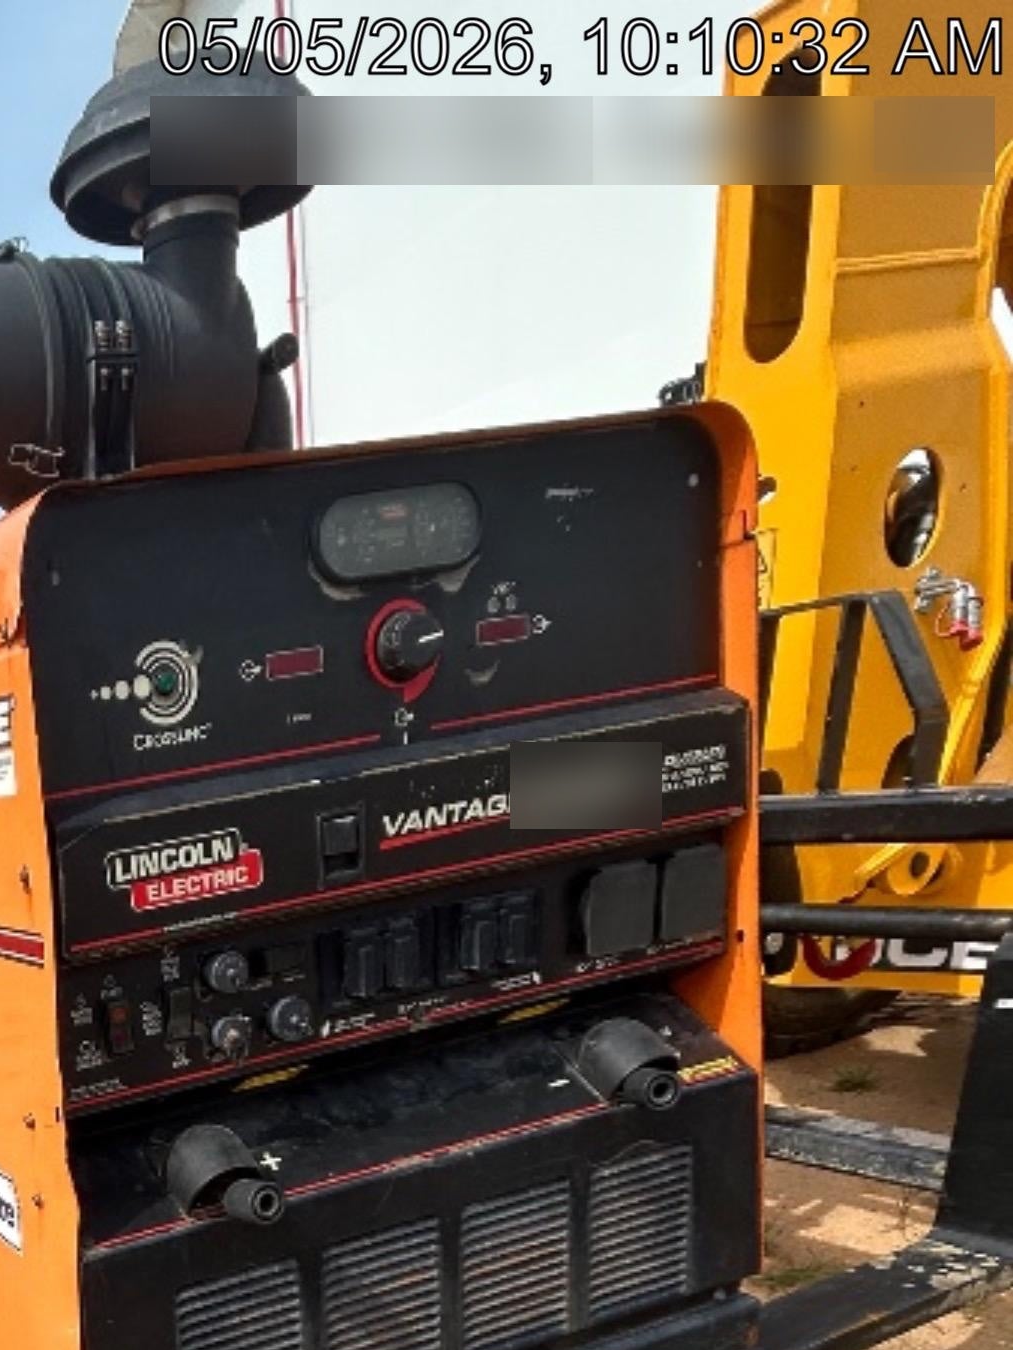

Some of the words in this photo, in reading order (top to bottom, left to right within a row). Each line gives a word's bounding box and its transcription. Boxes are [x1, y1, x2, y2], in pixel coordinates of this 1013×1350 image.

[382, 791, 510, 838] VANTAG
[114, 835, 235, 884] LINCOLN
[145, 866, 249, 902] ELECTRIC
